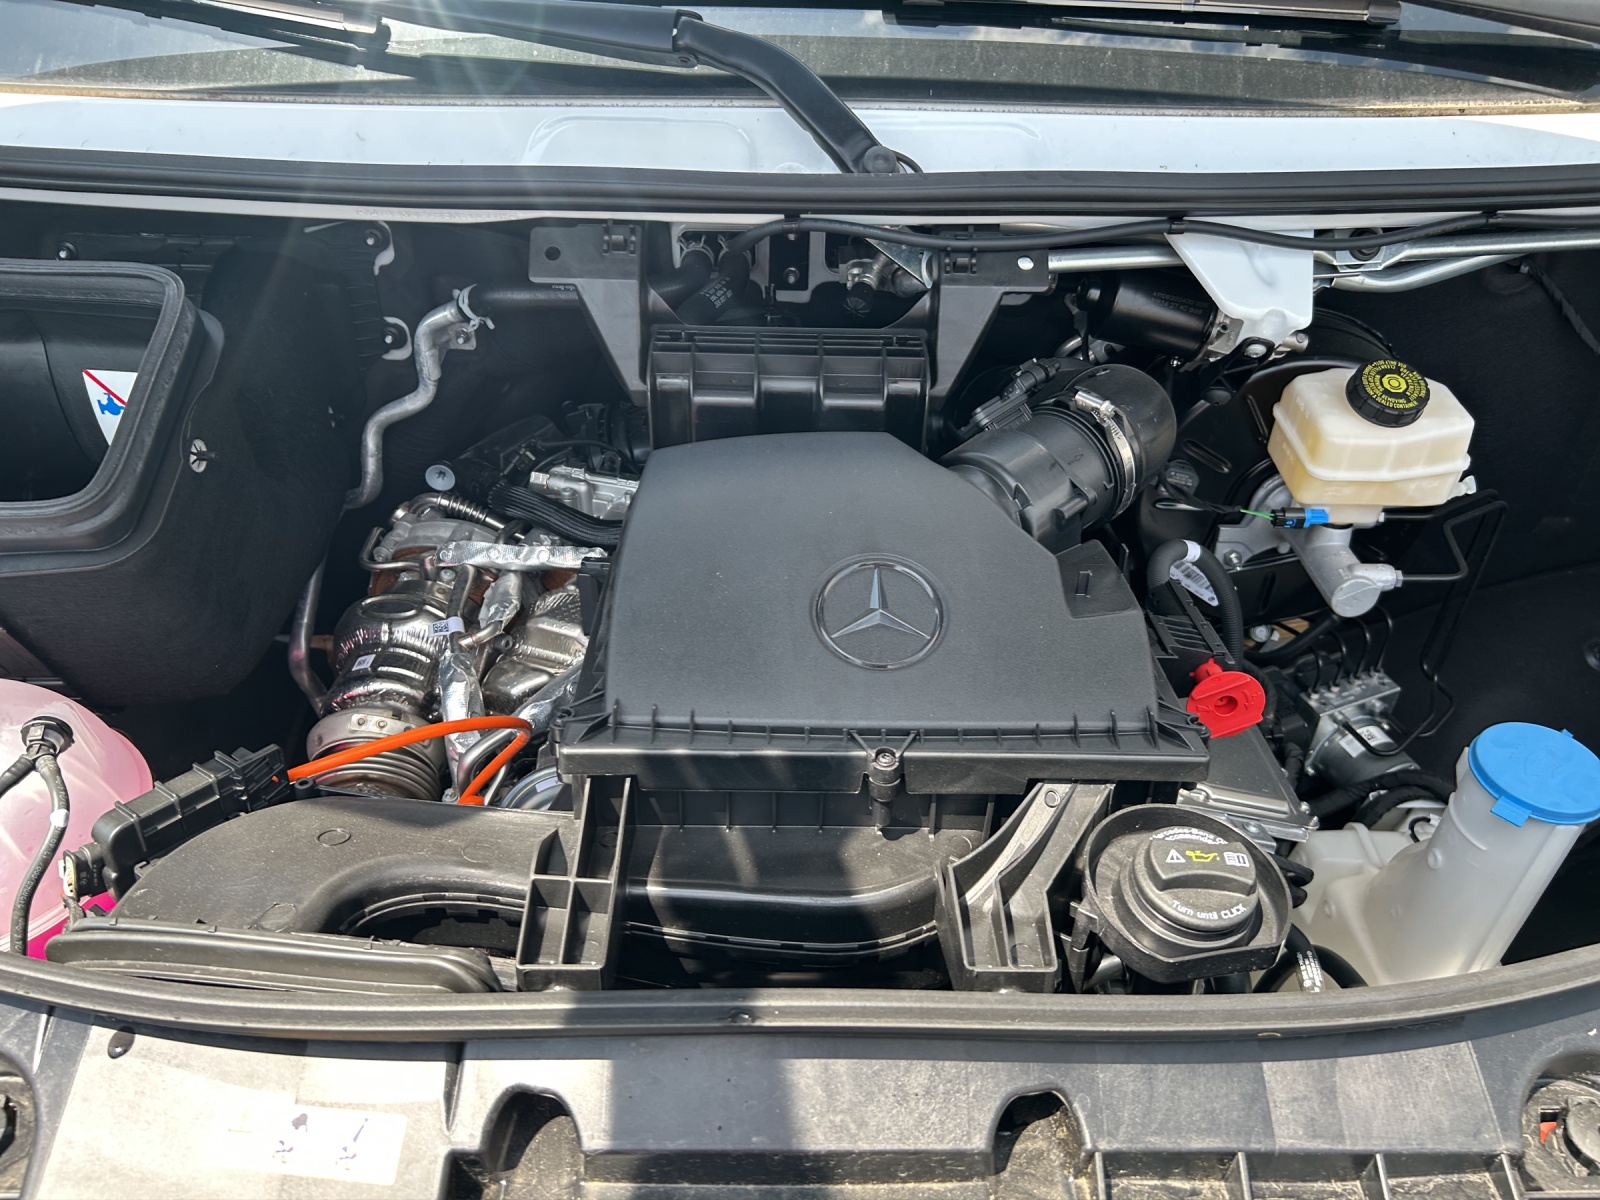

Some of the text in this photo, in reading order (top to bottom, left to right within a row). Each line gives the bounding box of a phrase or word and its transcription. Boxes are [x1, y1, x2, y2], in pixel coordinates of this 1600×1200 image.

[1374, 396, 1392, 407] SEALED
[1394, 399, 1418, 409] CONTAINER
[1172, 900, 1246, 920] Turn until CLICK
